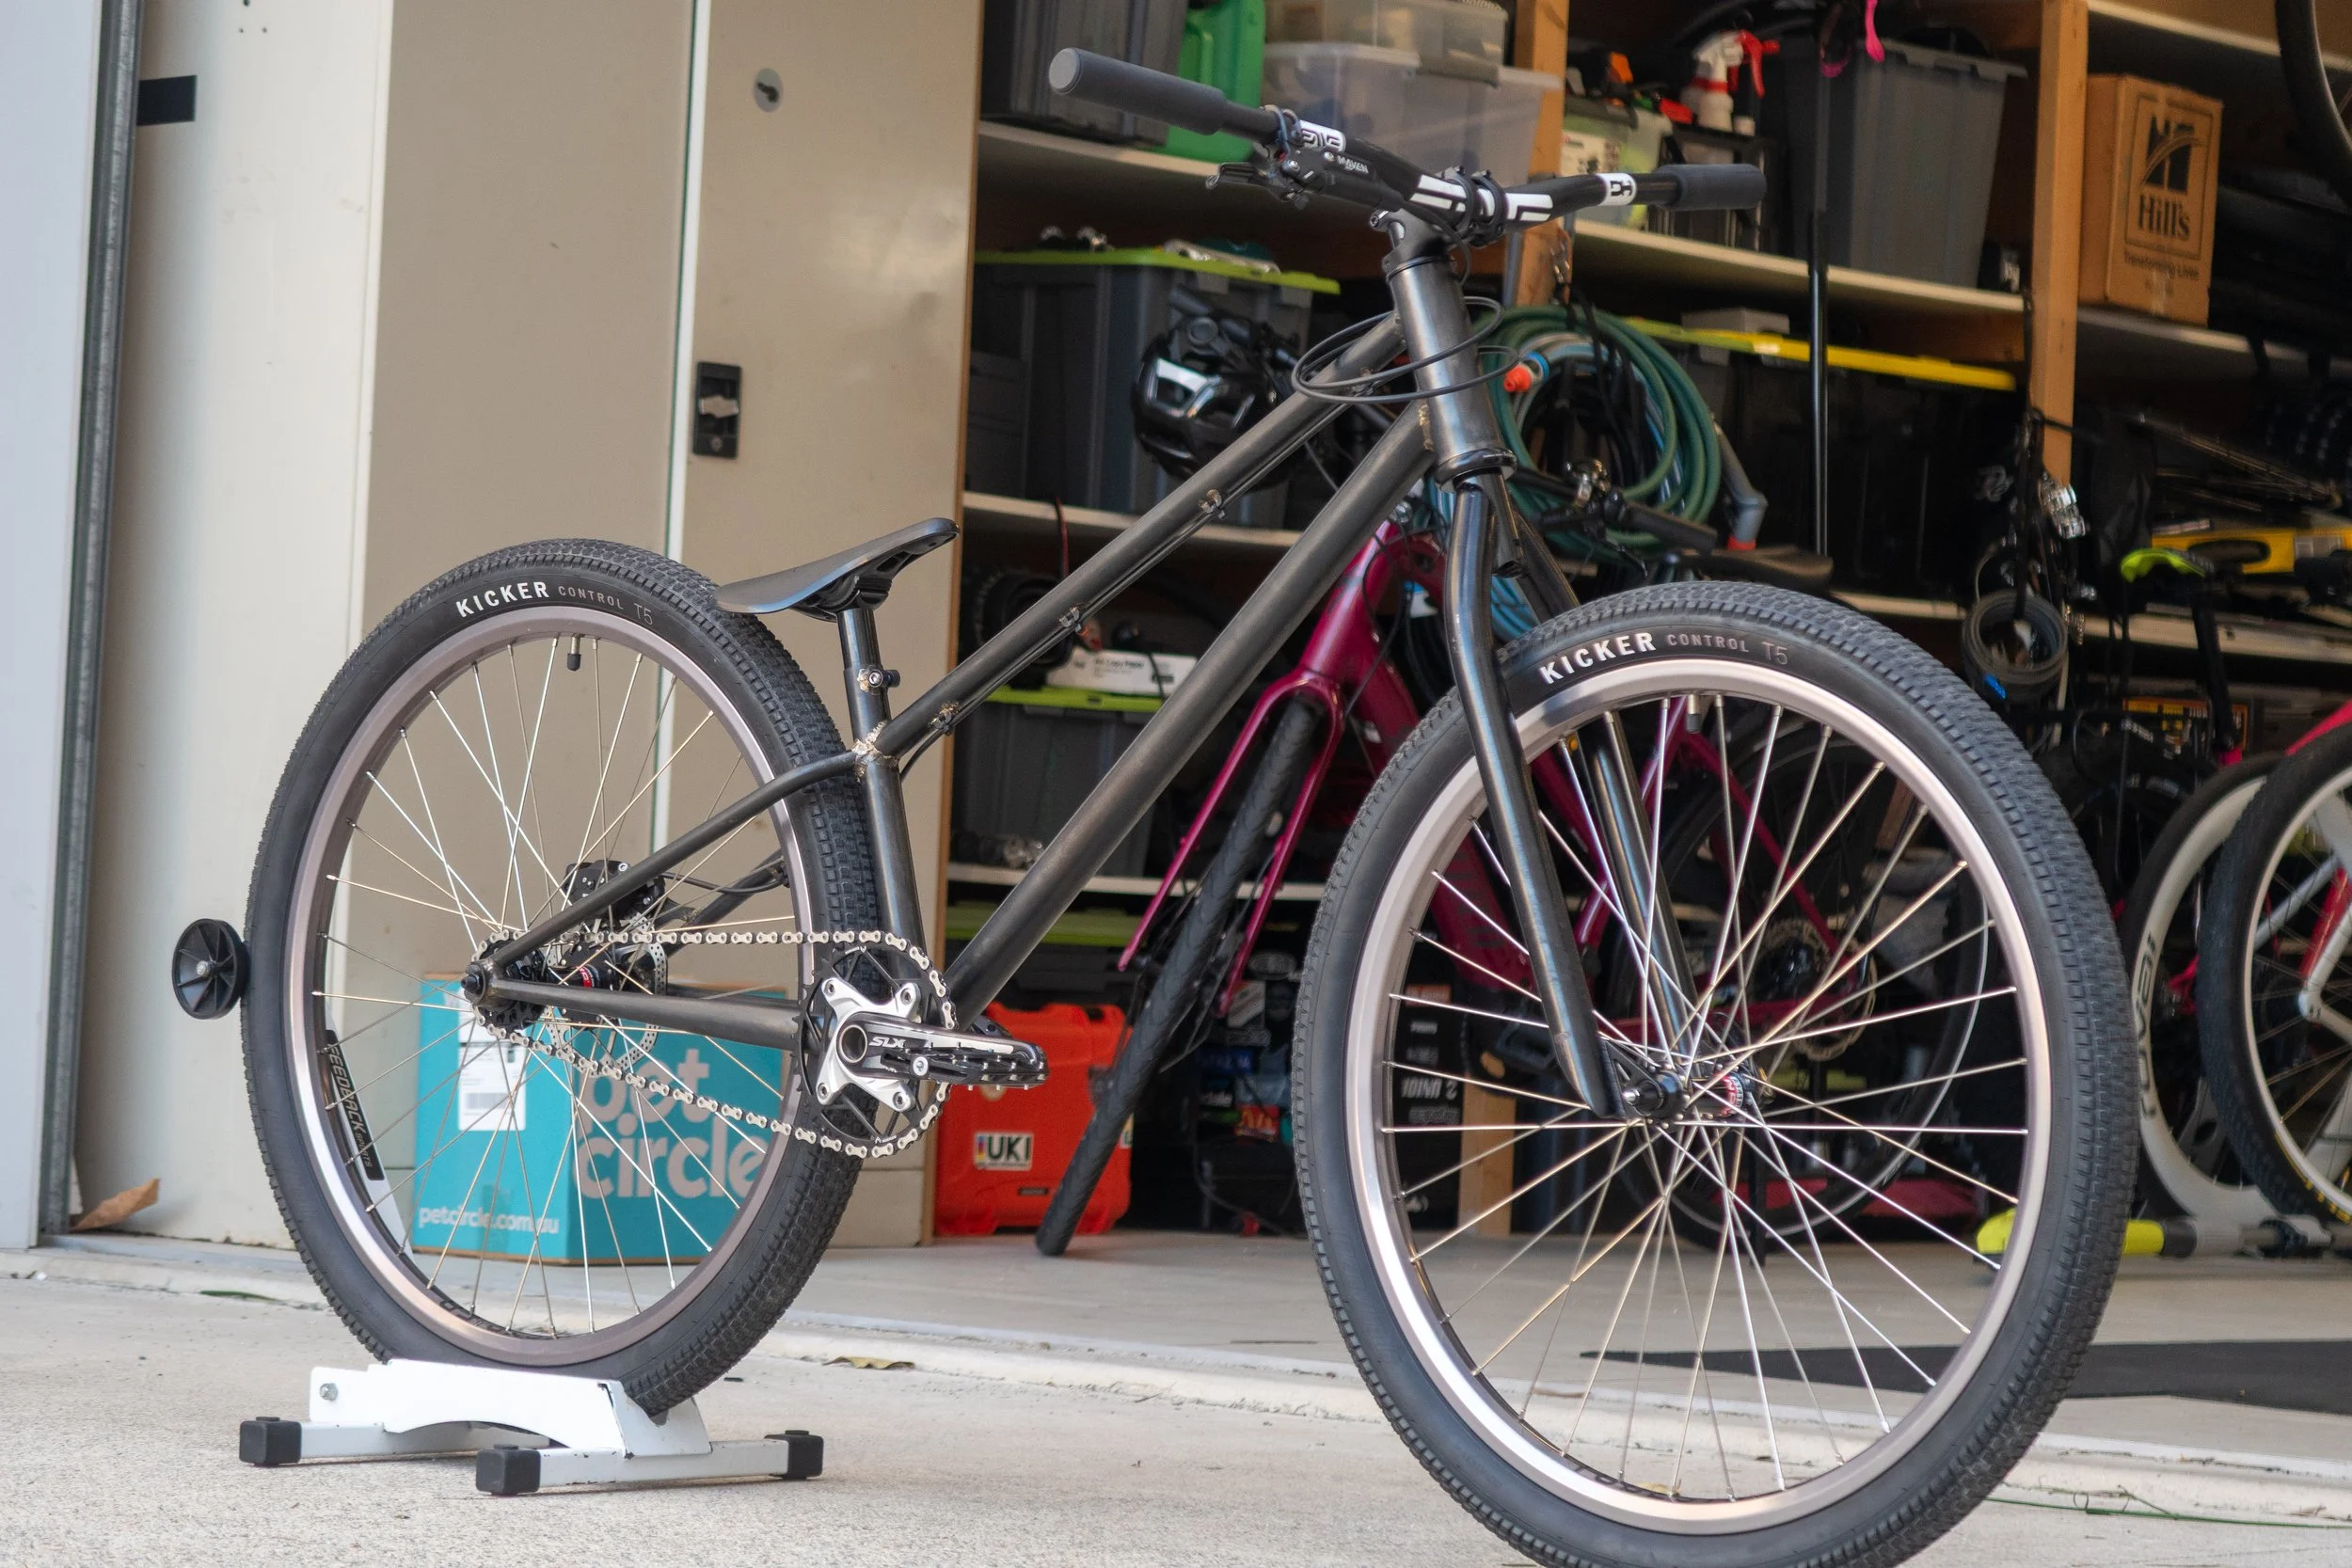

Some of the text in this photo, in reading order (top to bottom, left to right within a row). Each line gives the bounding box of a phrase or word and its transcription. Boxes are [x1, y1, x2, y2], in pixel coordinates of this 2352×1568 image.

[456, 581, 654, 626] KICKER CONTROL T5
[1538, 632, 1788, 686] KICKER CONTROL T5
[869, 1037, 906, 1049] SLX
[327, 1044, 367, 1134] FEEDBACK
[573, 1049, 771, 1198] pet circle
[988, 1135, 1031, 1160] UKI
